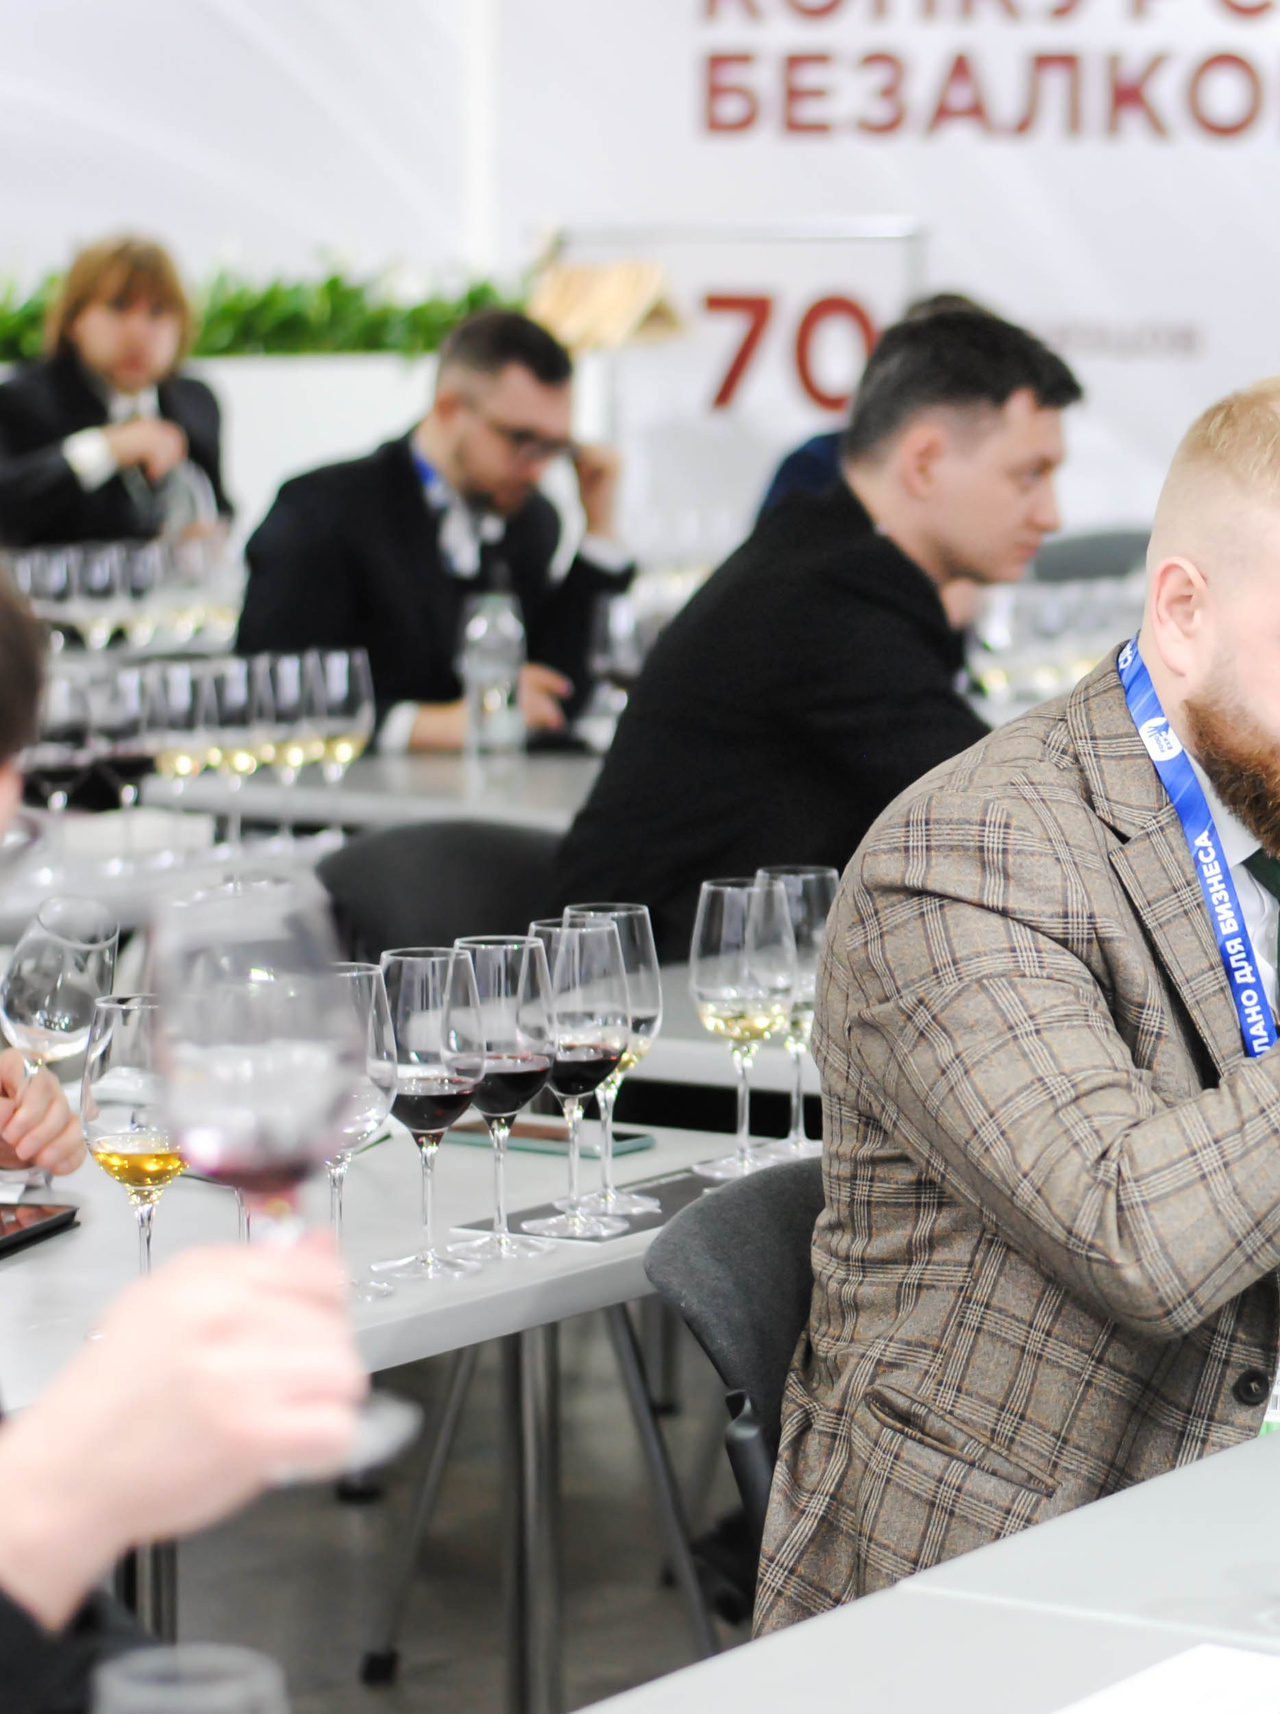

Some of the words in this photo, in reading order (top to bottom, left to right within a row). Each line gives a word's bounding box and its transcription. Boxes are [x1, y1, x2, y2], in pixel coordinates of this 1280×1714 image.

[702, 294, 877, 414] 70
[1194, 830, 1239, 936] БИЗНЕСА
[1225, 937, 1257, 984] ДЛЯ
[1240, 989, 1271, 1058] ЛАНО
